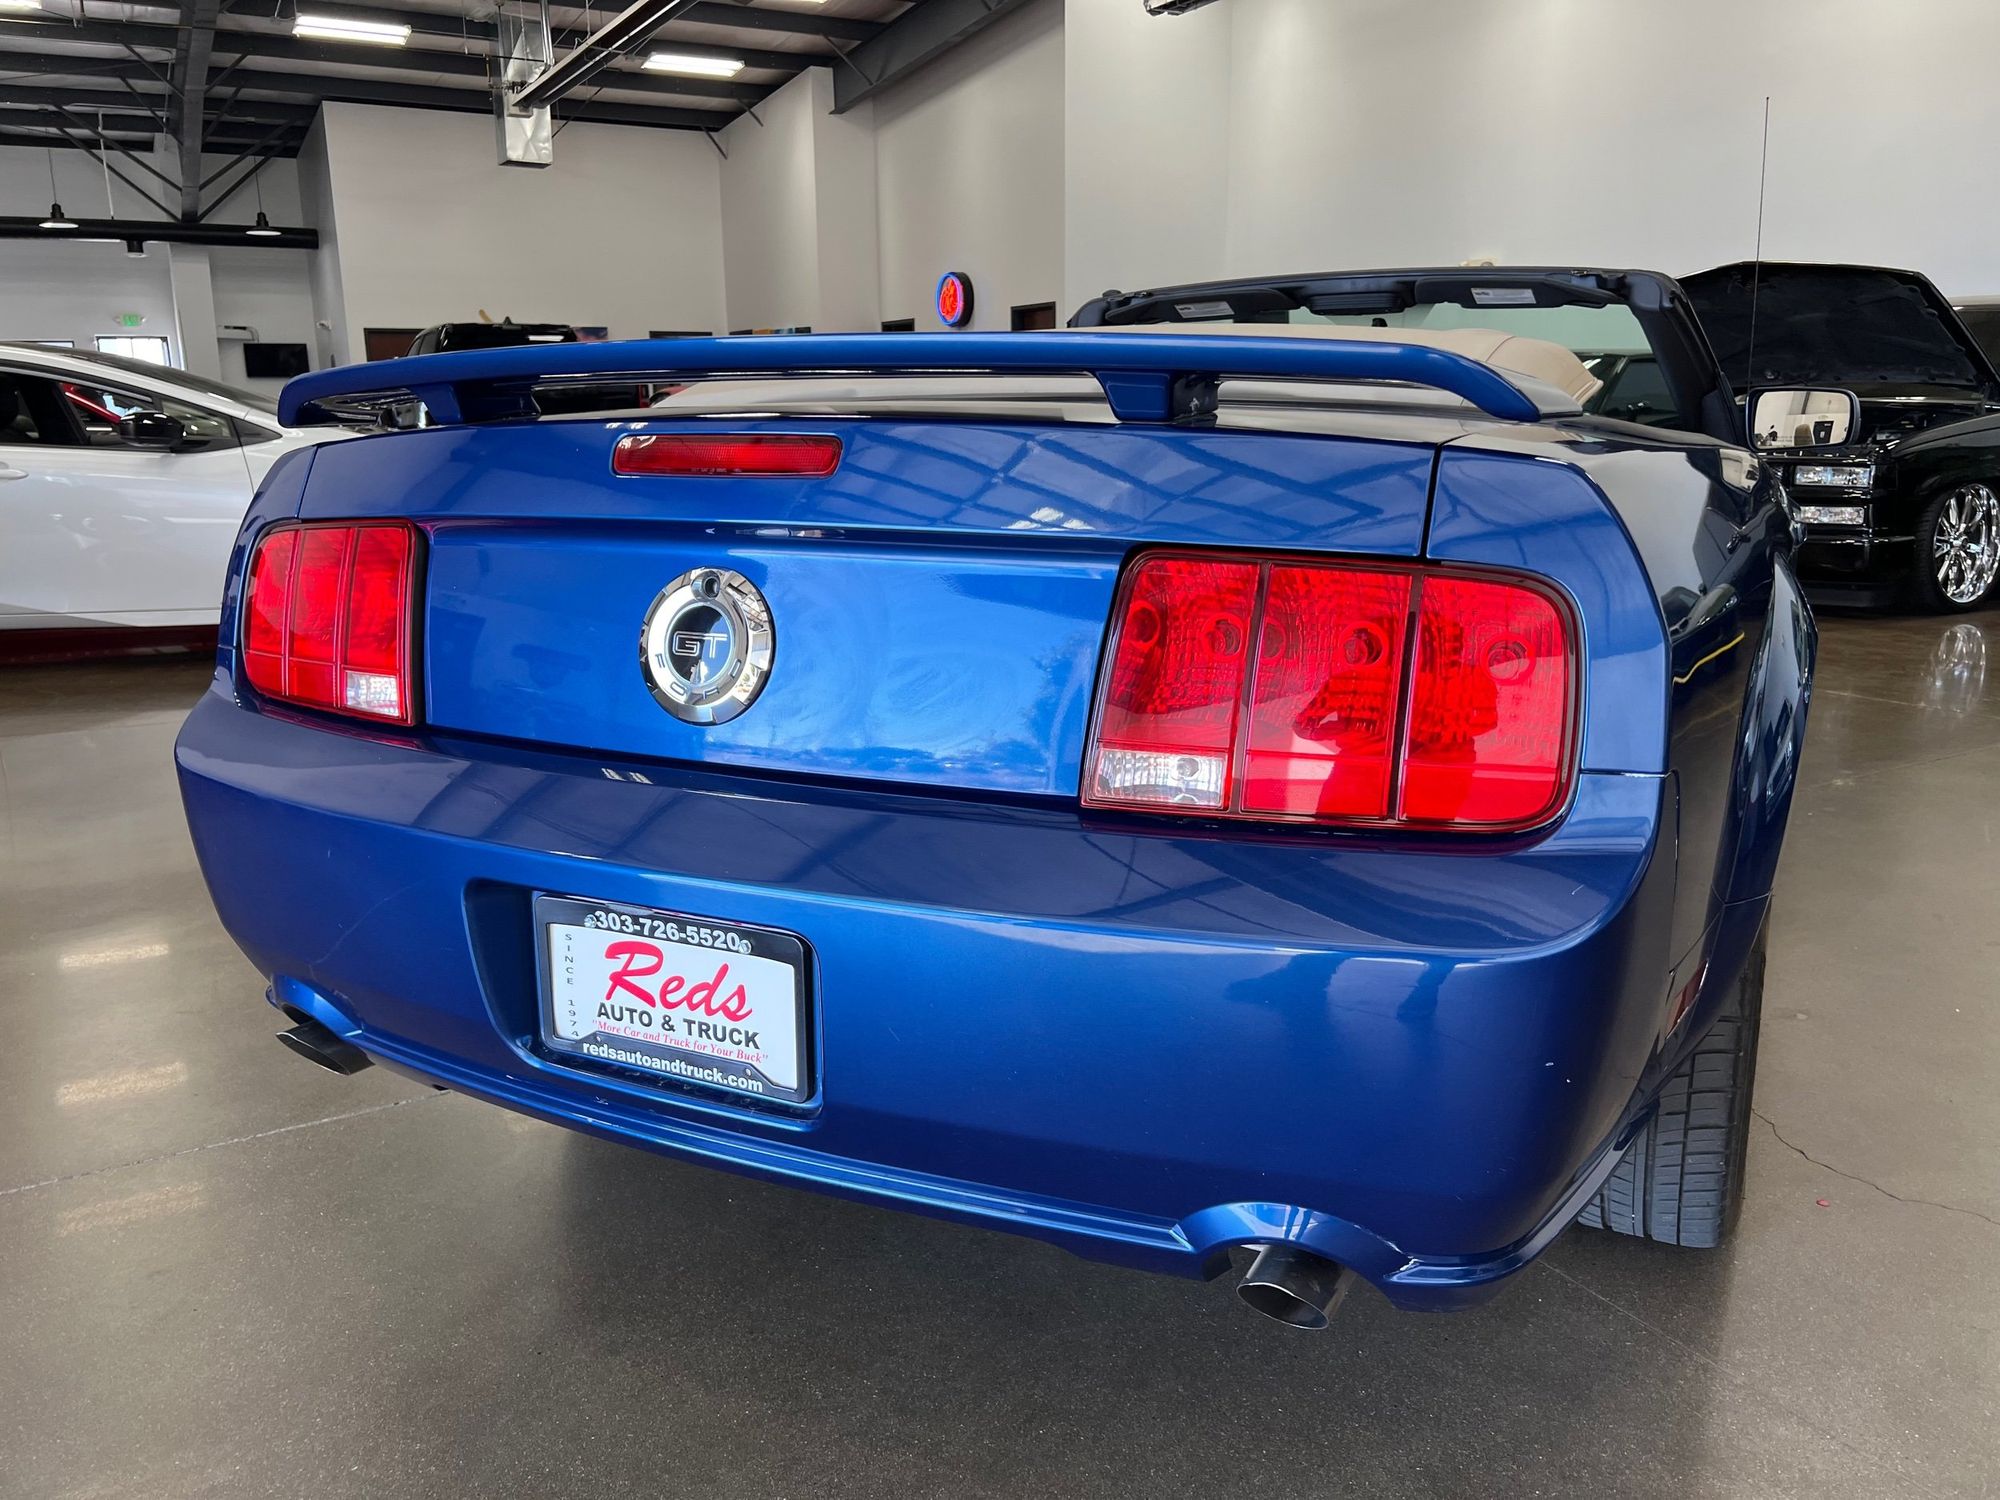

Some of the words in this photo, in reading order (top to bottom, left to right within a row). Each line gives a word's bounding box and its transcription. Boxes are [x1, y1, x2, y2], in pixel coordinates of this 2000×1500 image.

[672, 631, 728, 659] GT
[595, 910, 739, 950] 303-726-5520
[564, 933, 574, 985] SINCE
[605, 940, 752, 1022] Reds
[568, 999, 579, 1037] 1974
[597, 1002, 653, 1028] AUTO
[661, 1014, 676, 1033] &
[683, 1018, 761, 1050] TRUCK
[624, 1026, 641, 1038] Car
[643, 1030, 661, 1042] and
[663, 1034, 691, 1049] Truck
[693, 1040, 708, 1052] for
[710, 1044, 734, 1057] Your
[582, 1041, 763, 1092] redsautoandtruck.com
